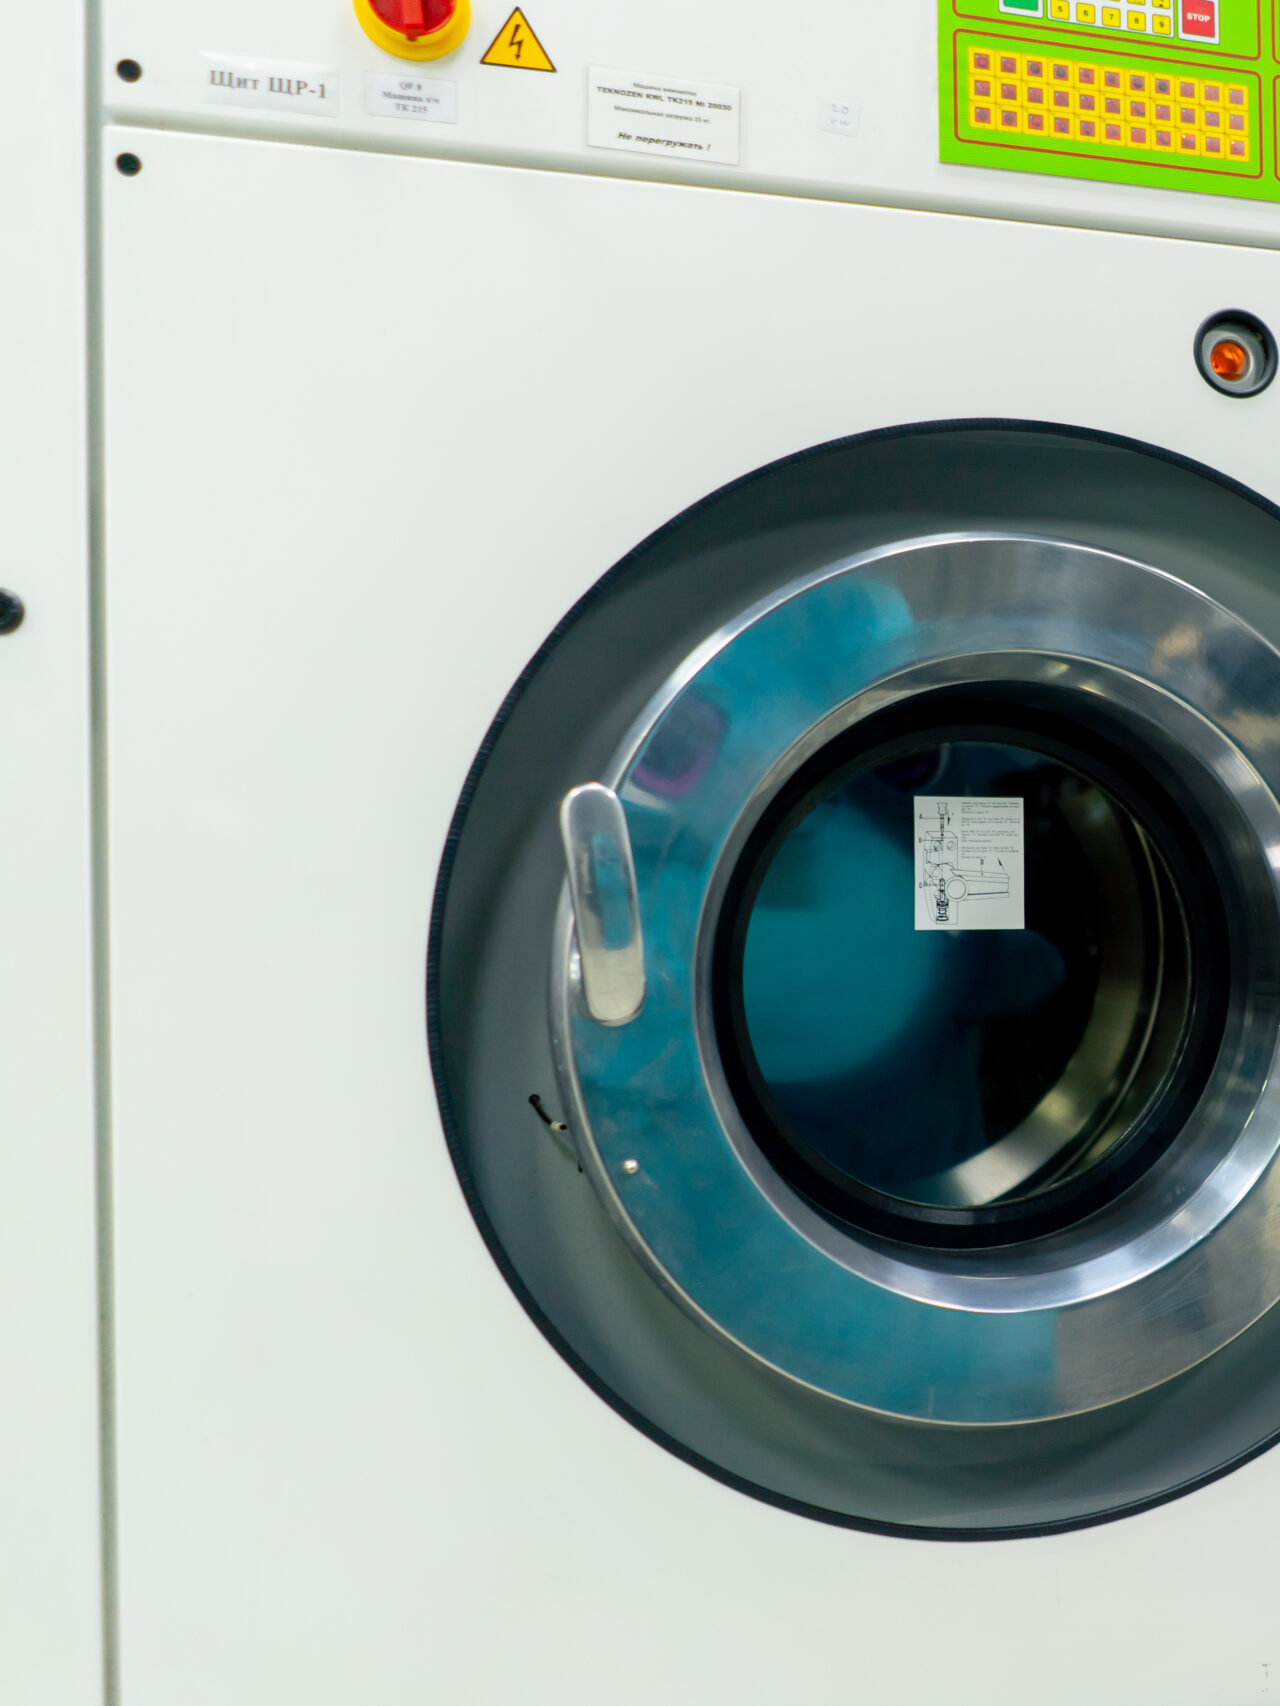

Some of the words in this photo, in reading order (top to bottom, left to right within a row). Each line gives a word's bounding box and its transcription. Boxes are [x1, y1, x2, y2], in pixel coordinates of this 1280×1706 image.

[1057, 5, 1063, 13] 5
[1083, 9, 1089, 17] 6
[1134, 17, 1140, 25] 8
[1186, 12, 1211, 23] STOP
[209, 69, 260, 90] Щит
[268, 76, 328, 99] ЩР-1
[597, 86, 643, 98] TEKNOZEN
[617, 131, 632, 141] Не
[635, 135, 703, 151] перегружать
